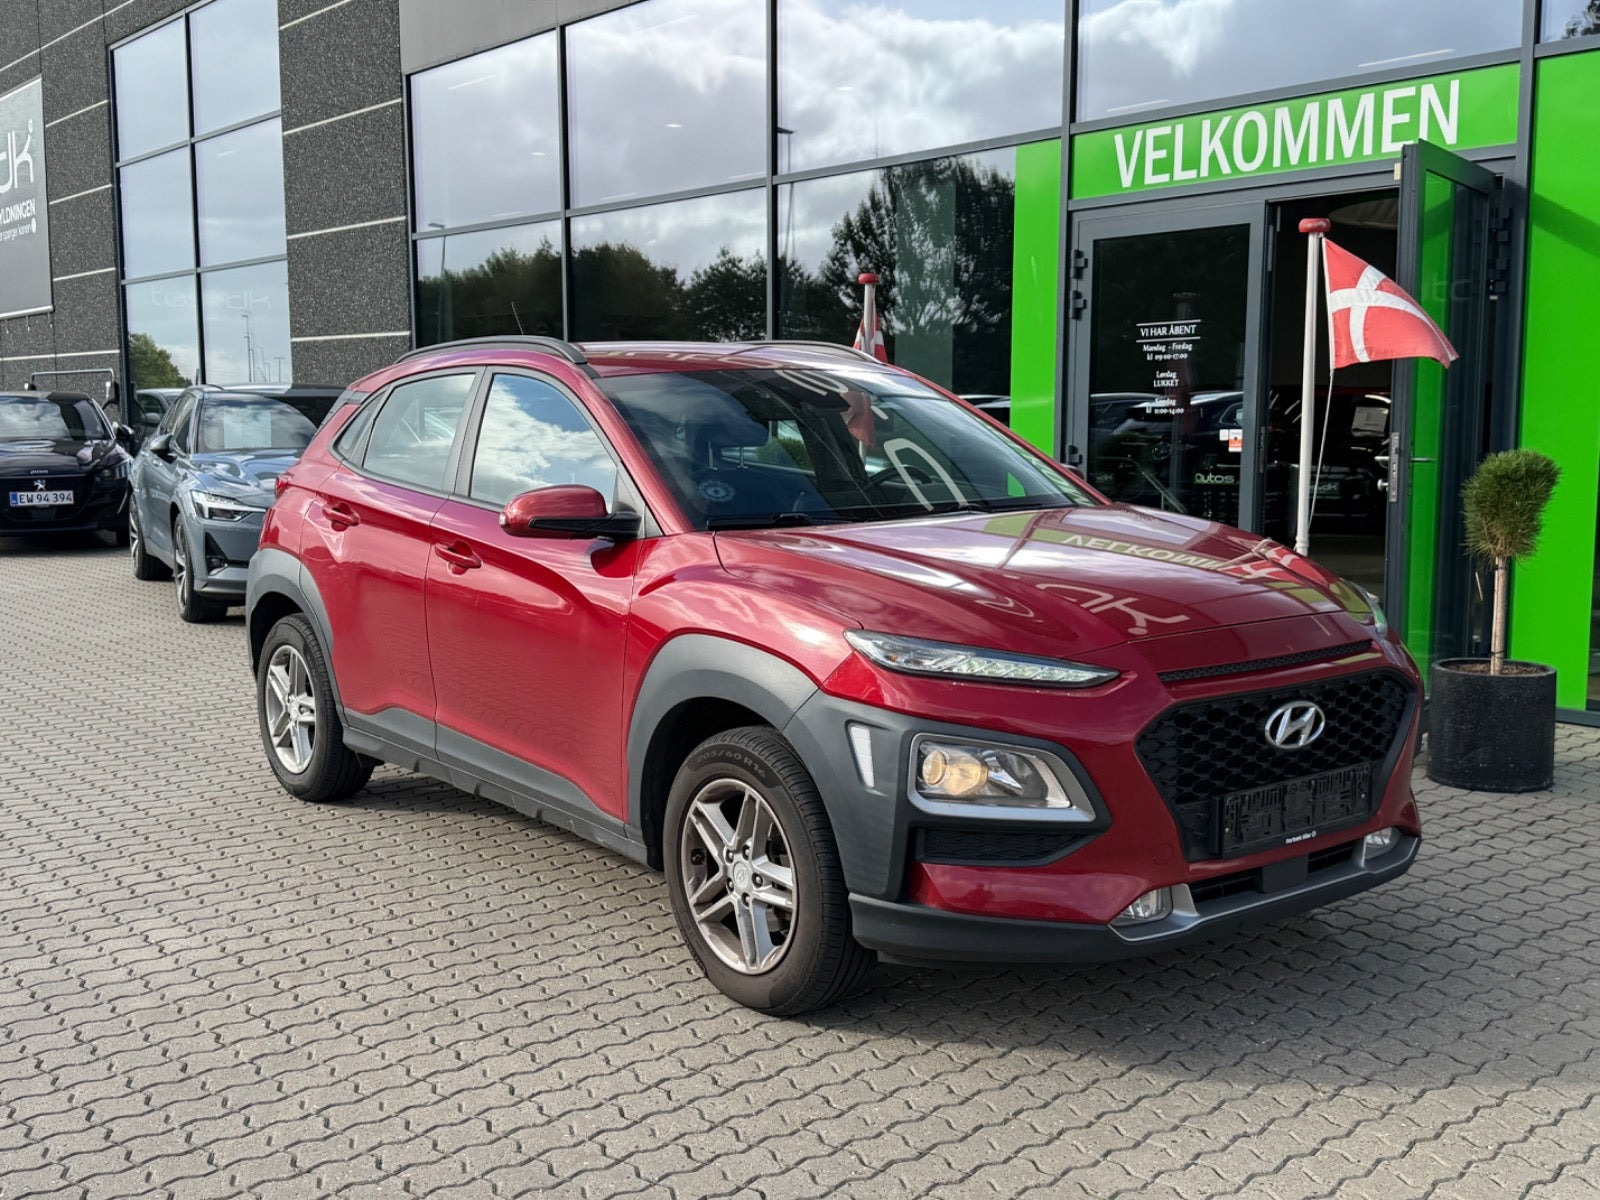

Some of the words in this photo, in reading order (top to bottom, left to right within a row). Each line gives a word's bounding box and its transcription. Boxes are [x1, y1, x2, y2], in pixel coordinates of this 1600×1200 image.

[1114, 79, 1460, 188] VELKOMMEN
[1140, 328, 1149, 337] VI
[1150, 326, 1167, 336] HAR
[1168, 324, 1197, 335] ÅBENT
[1142, 343, 1166, 352] Mandag
[1153, 379, 1180, 388] LUKKET
[19, 494, 34, 504] EW
[36, 493, 49, 503] 94
[52, 492, 73, 503] 394
